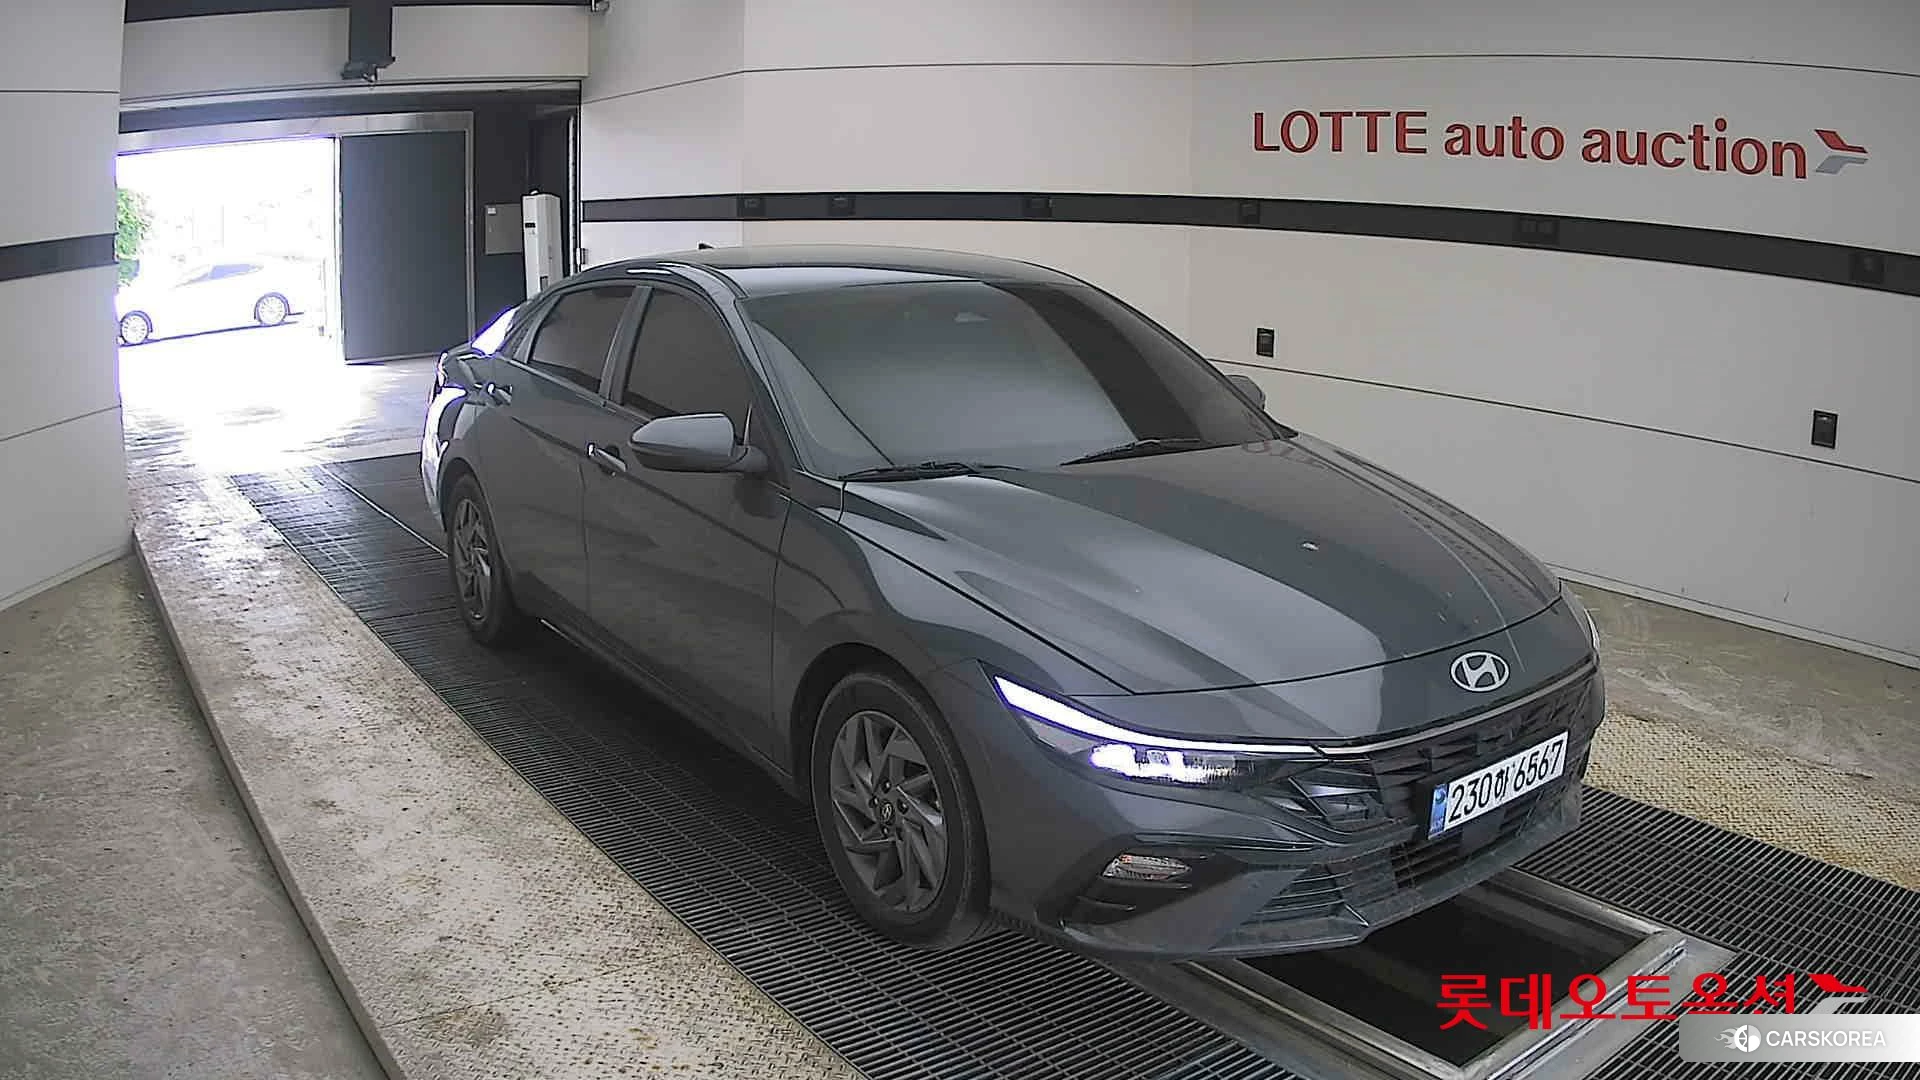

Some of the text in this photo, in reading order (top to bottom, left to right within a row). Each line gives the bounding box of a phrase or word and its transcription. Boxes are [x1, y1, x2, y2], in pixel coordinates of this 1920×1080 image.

[1253, 110, 1807, 180] LOTTE auto auction
